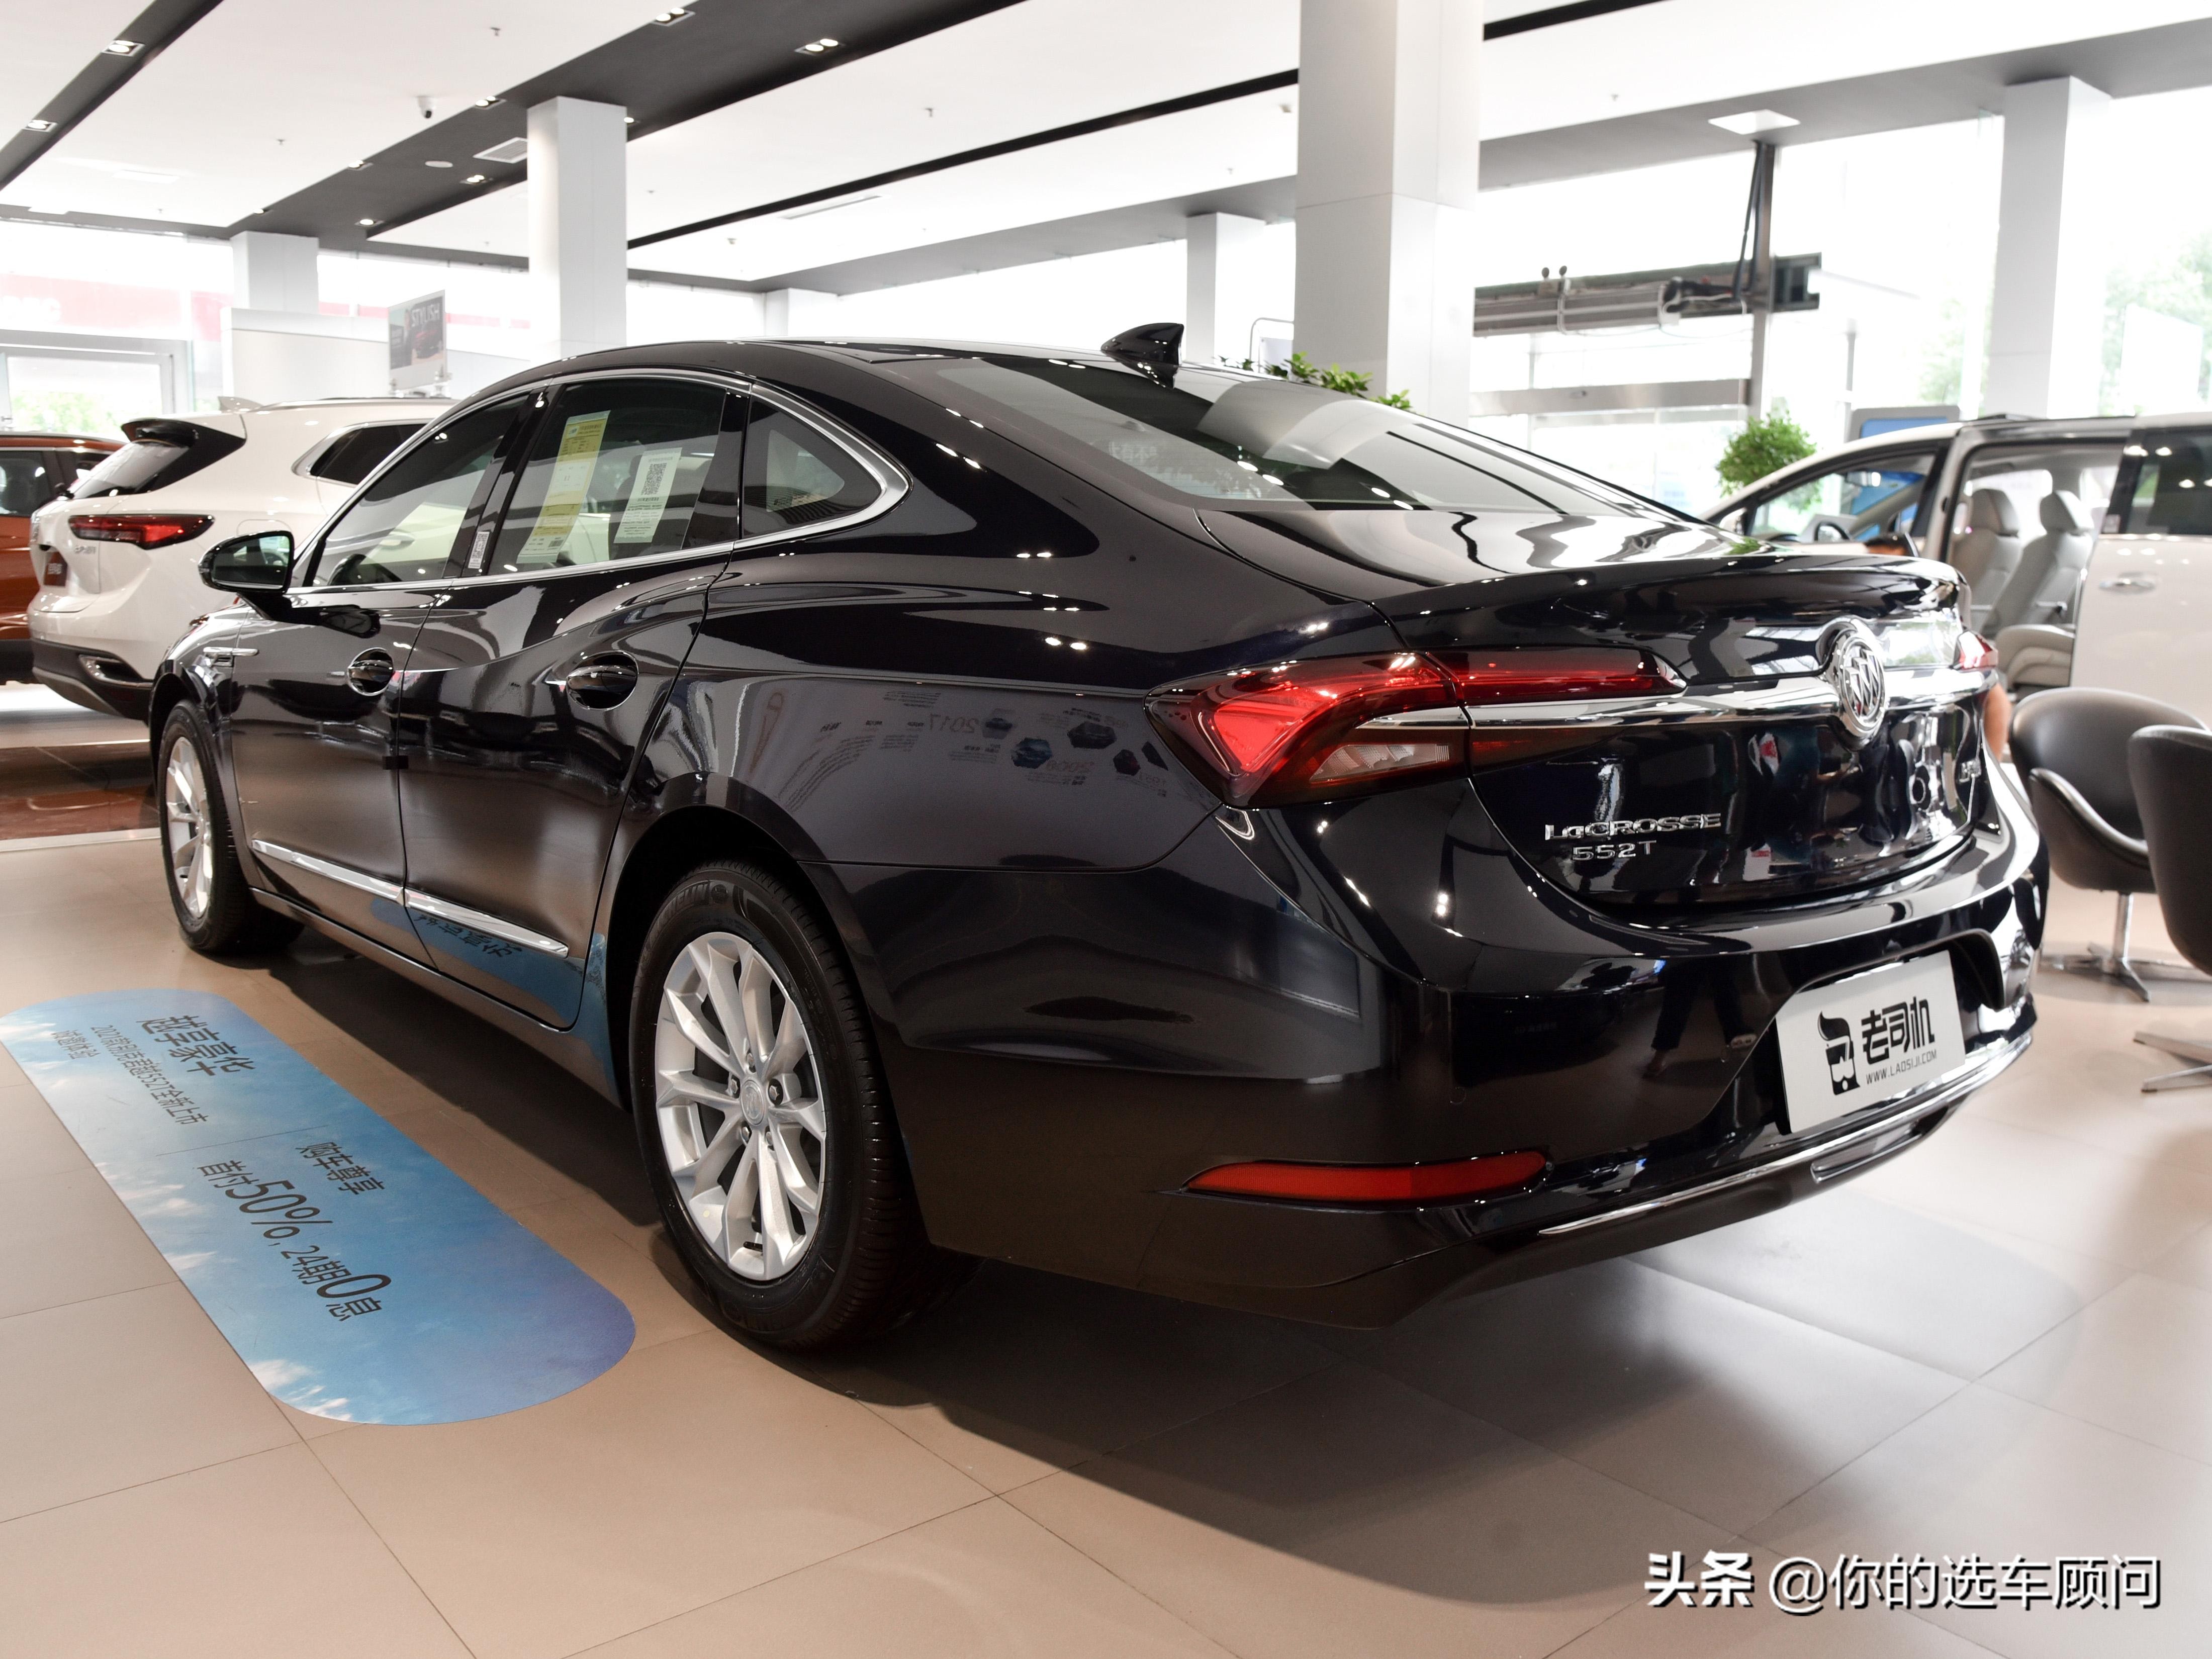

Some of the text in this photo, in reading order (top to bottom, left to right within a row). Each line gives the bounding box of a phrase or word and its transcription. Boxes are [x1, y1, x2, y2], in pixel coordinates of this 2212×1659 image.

[1572, 840, 1657, 861] 552T
[136, 1015, 256, 1076] 越享豪华
[1861, 996, 1935, 1065] 老司机
[1866, 1049, 1937, 1084] WWW.LAOSIJI.COM
[295, 1142, 385, 1195] 购车尊享
